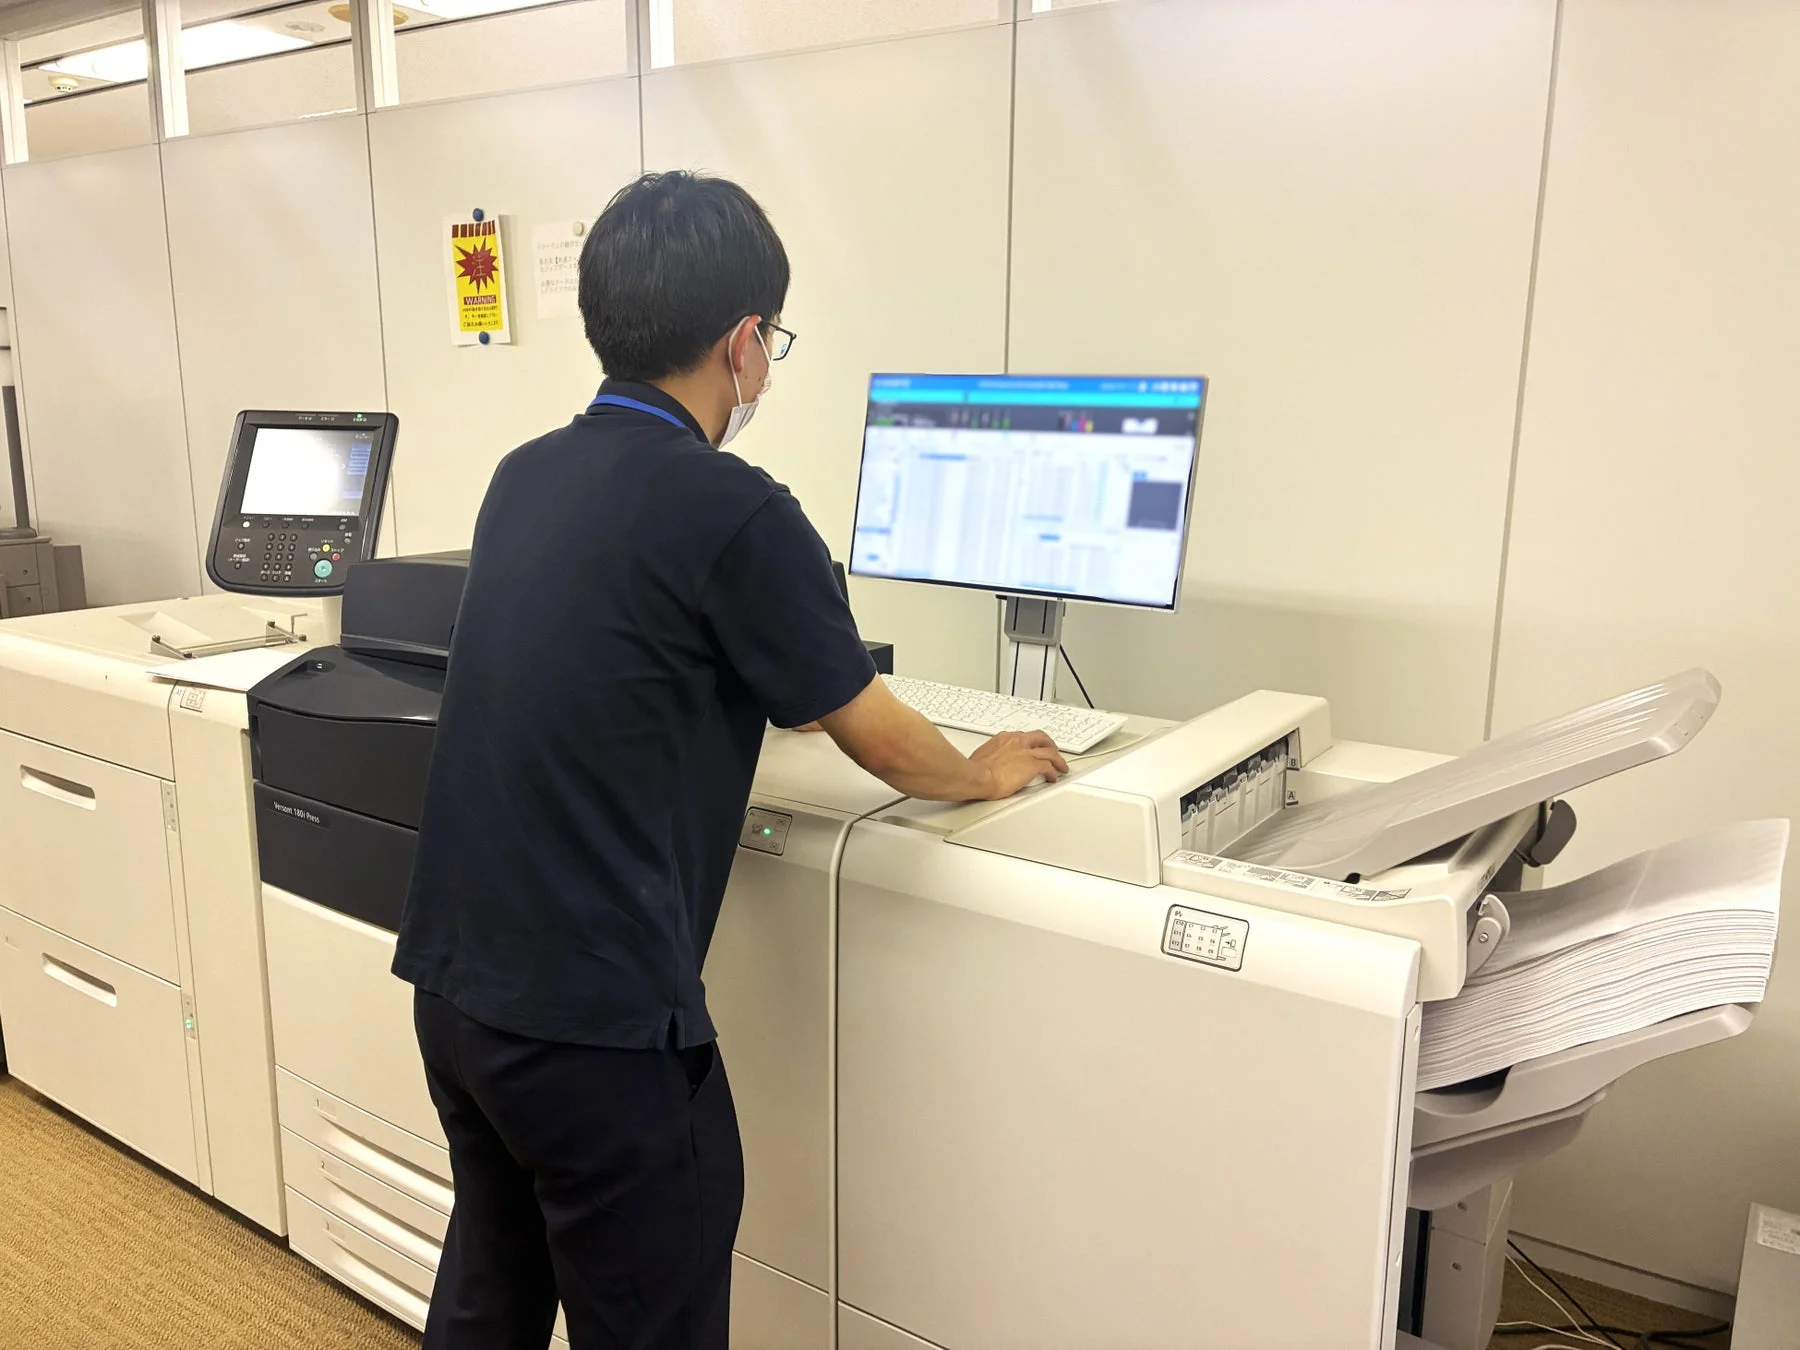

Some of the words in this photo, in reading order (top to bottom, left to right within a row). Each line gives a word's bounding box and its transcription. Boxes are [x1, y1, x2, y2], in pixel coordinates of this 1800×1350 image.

[471, 254, 488, 277] 注
[465, 296, 496, 305] WARNING
[273, 801, 294, 815] Versant
[306, 812, 320, 824] Press
